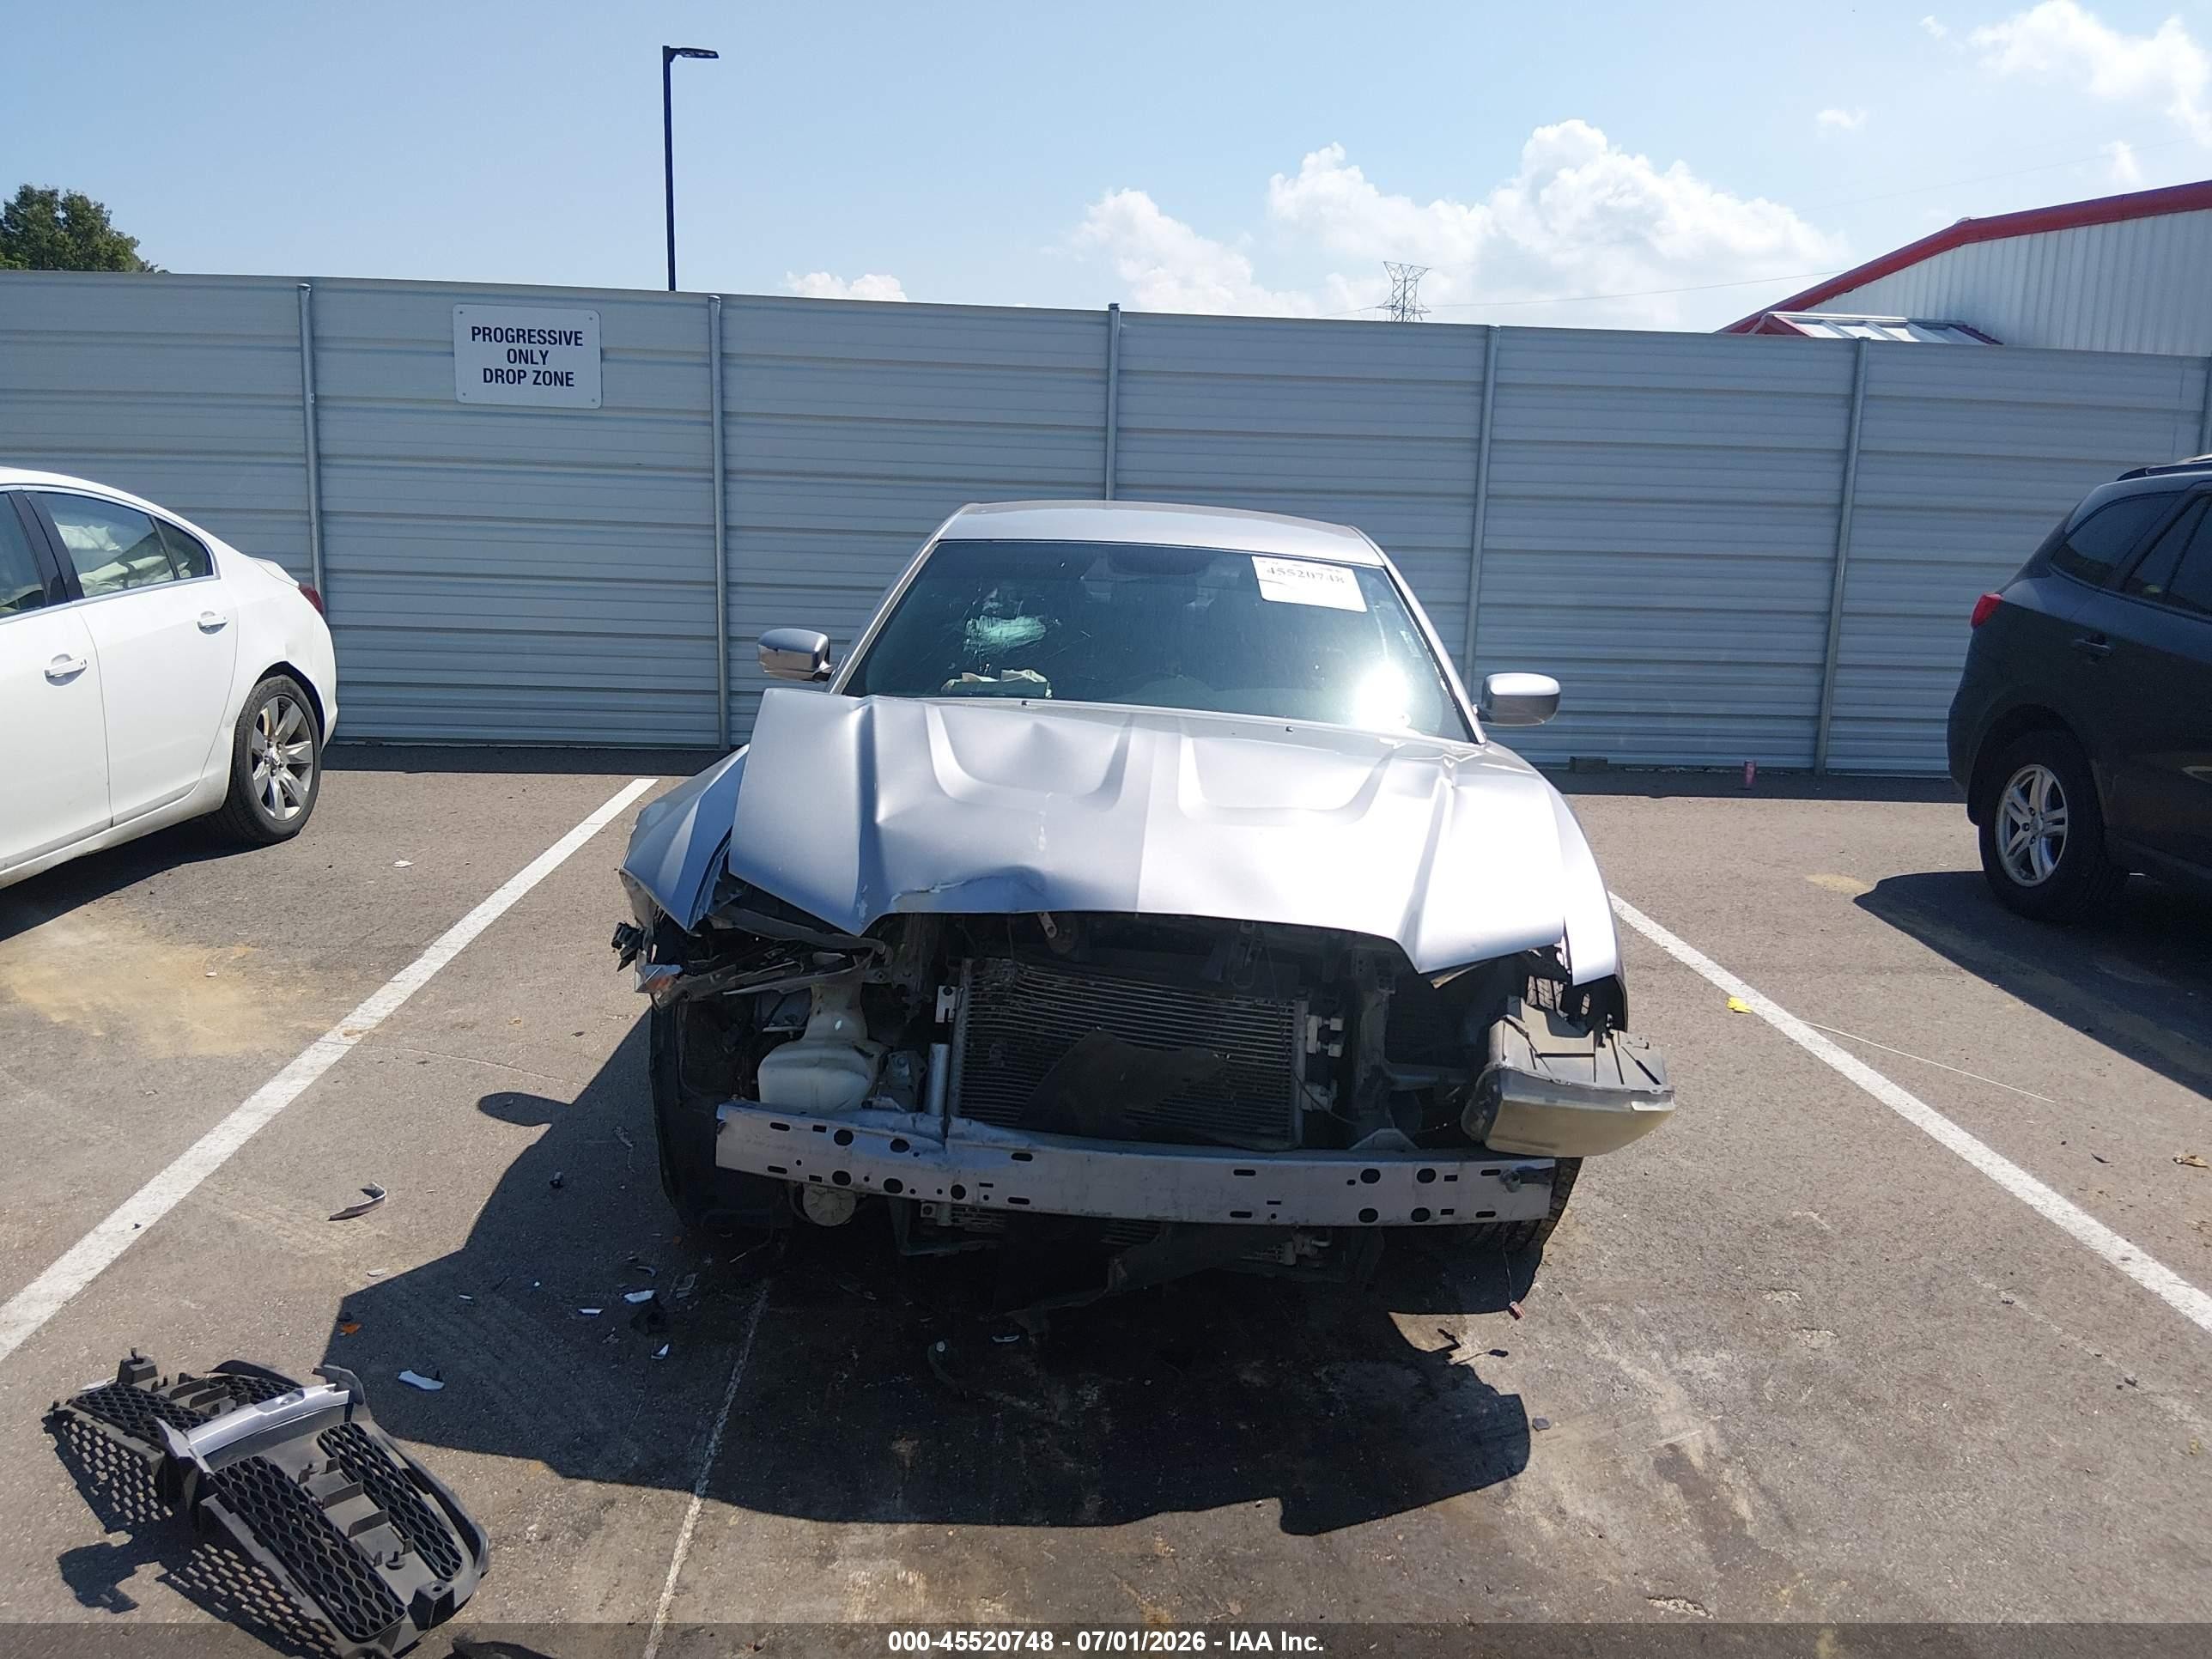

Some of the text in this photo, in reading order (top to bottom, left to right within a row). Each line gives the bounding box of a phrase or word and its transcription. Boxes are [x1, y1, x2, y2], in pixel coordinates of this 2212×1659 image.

[471, 326, 583, 346] PROGRESSIVE
[507, 348, 550, 365] ONLY
[483, 368, 575, 386] DROP ZONE
